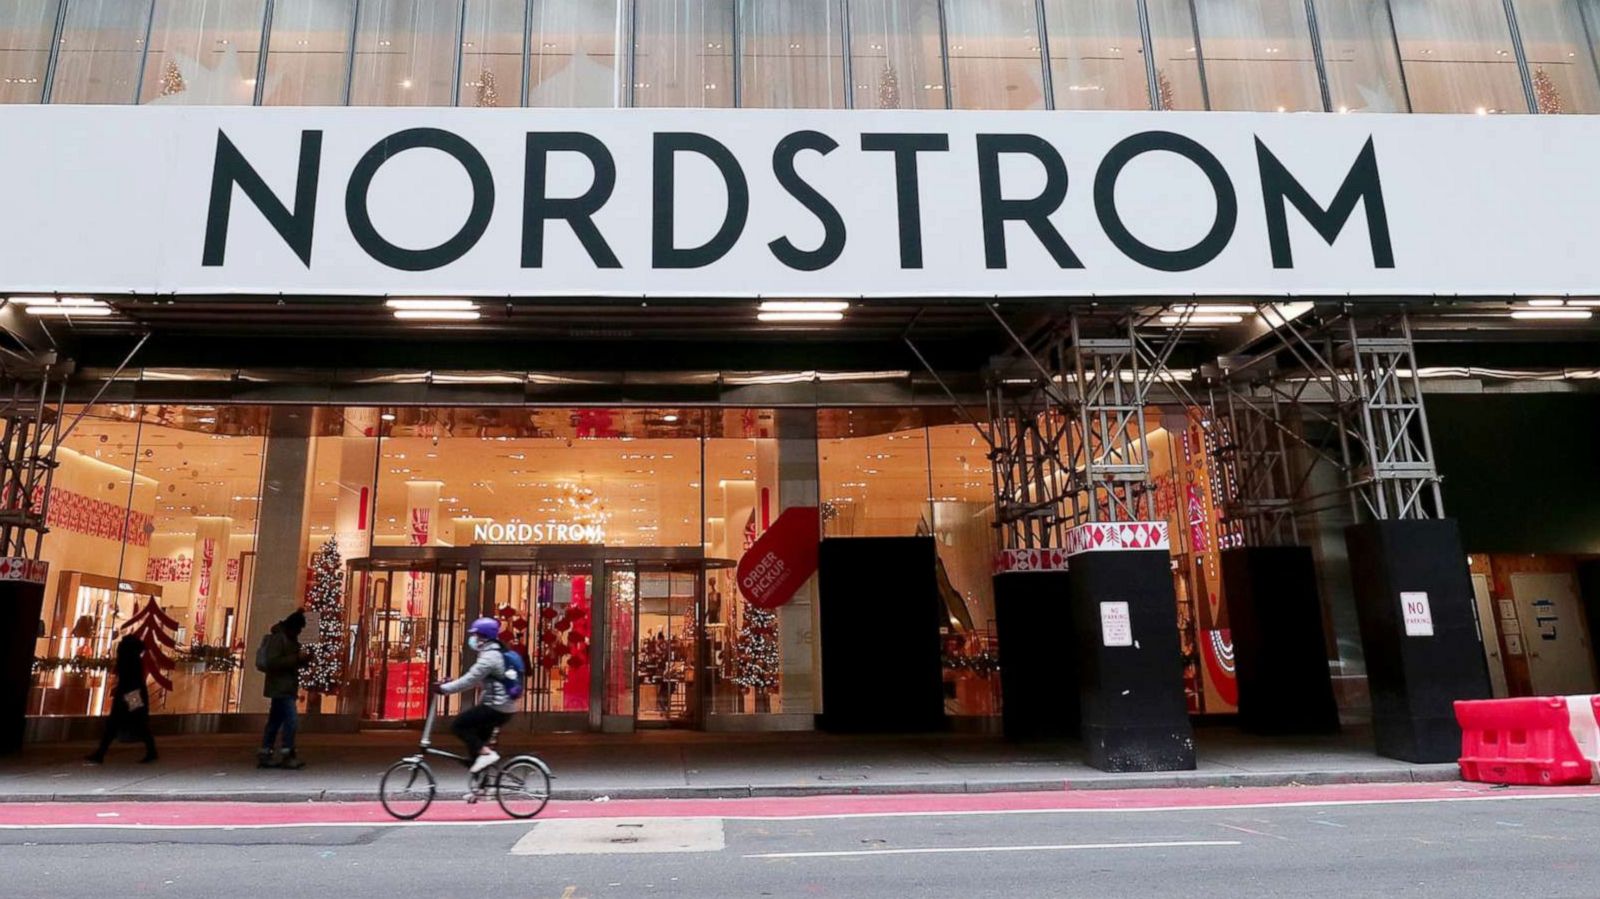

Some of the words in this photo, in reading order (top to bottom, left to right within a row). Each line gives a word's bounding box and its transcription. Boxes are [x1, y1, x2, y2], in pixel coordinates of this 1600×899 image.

[202, 127, 1395, 272] NORDSTROM
[474, 523, 603, 541] NORDSTROM
[743, 551, 778, 588] ORDER
[751, 559, 785, 598] PICKUP
[1406, 617, 1431, 625] PARKING
[1407, 601, 1424, 615] NO
